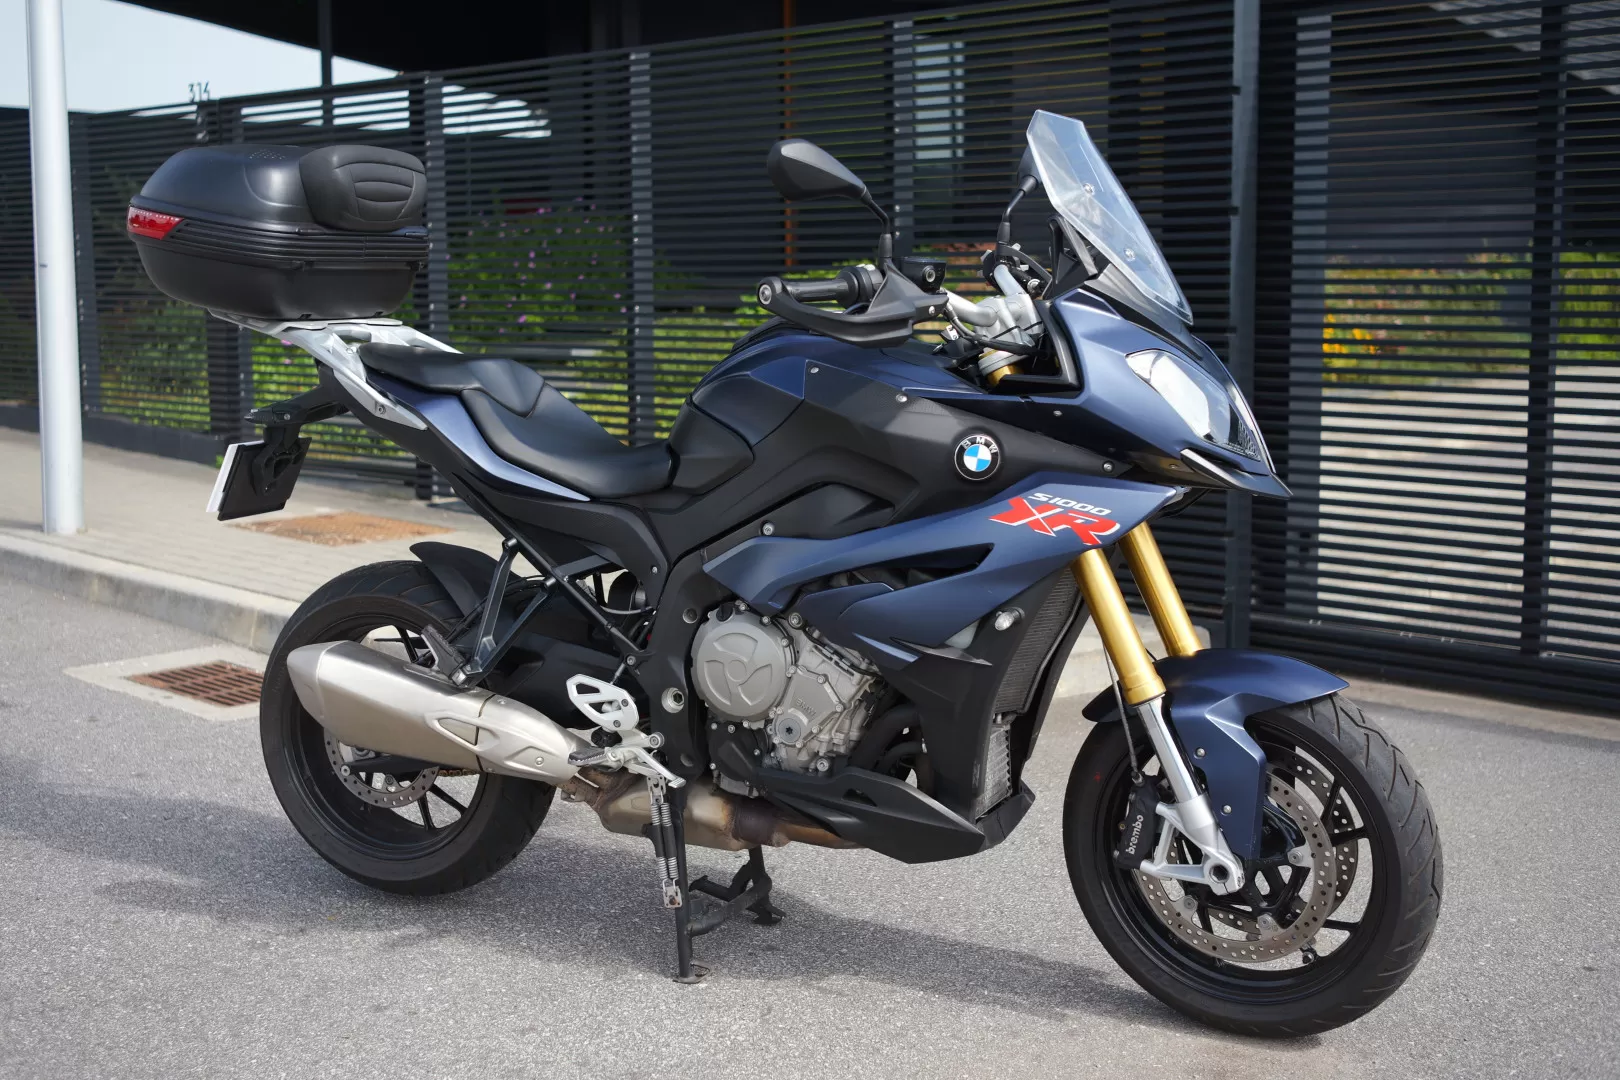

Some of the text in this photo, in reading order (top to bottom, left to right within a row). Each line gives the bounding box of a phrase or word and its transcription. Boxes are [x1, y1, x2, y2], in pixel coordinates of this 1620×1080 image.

[188, 80, 211, 102] 314
[961, 436, 998, 453] BMW
[1028, 493, 1112, 516] S1000
[988, 497, 1121, 546] XR
[1125, 815, 1144, 855] brembo
